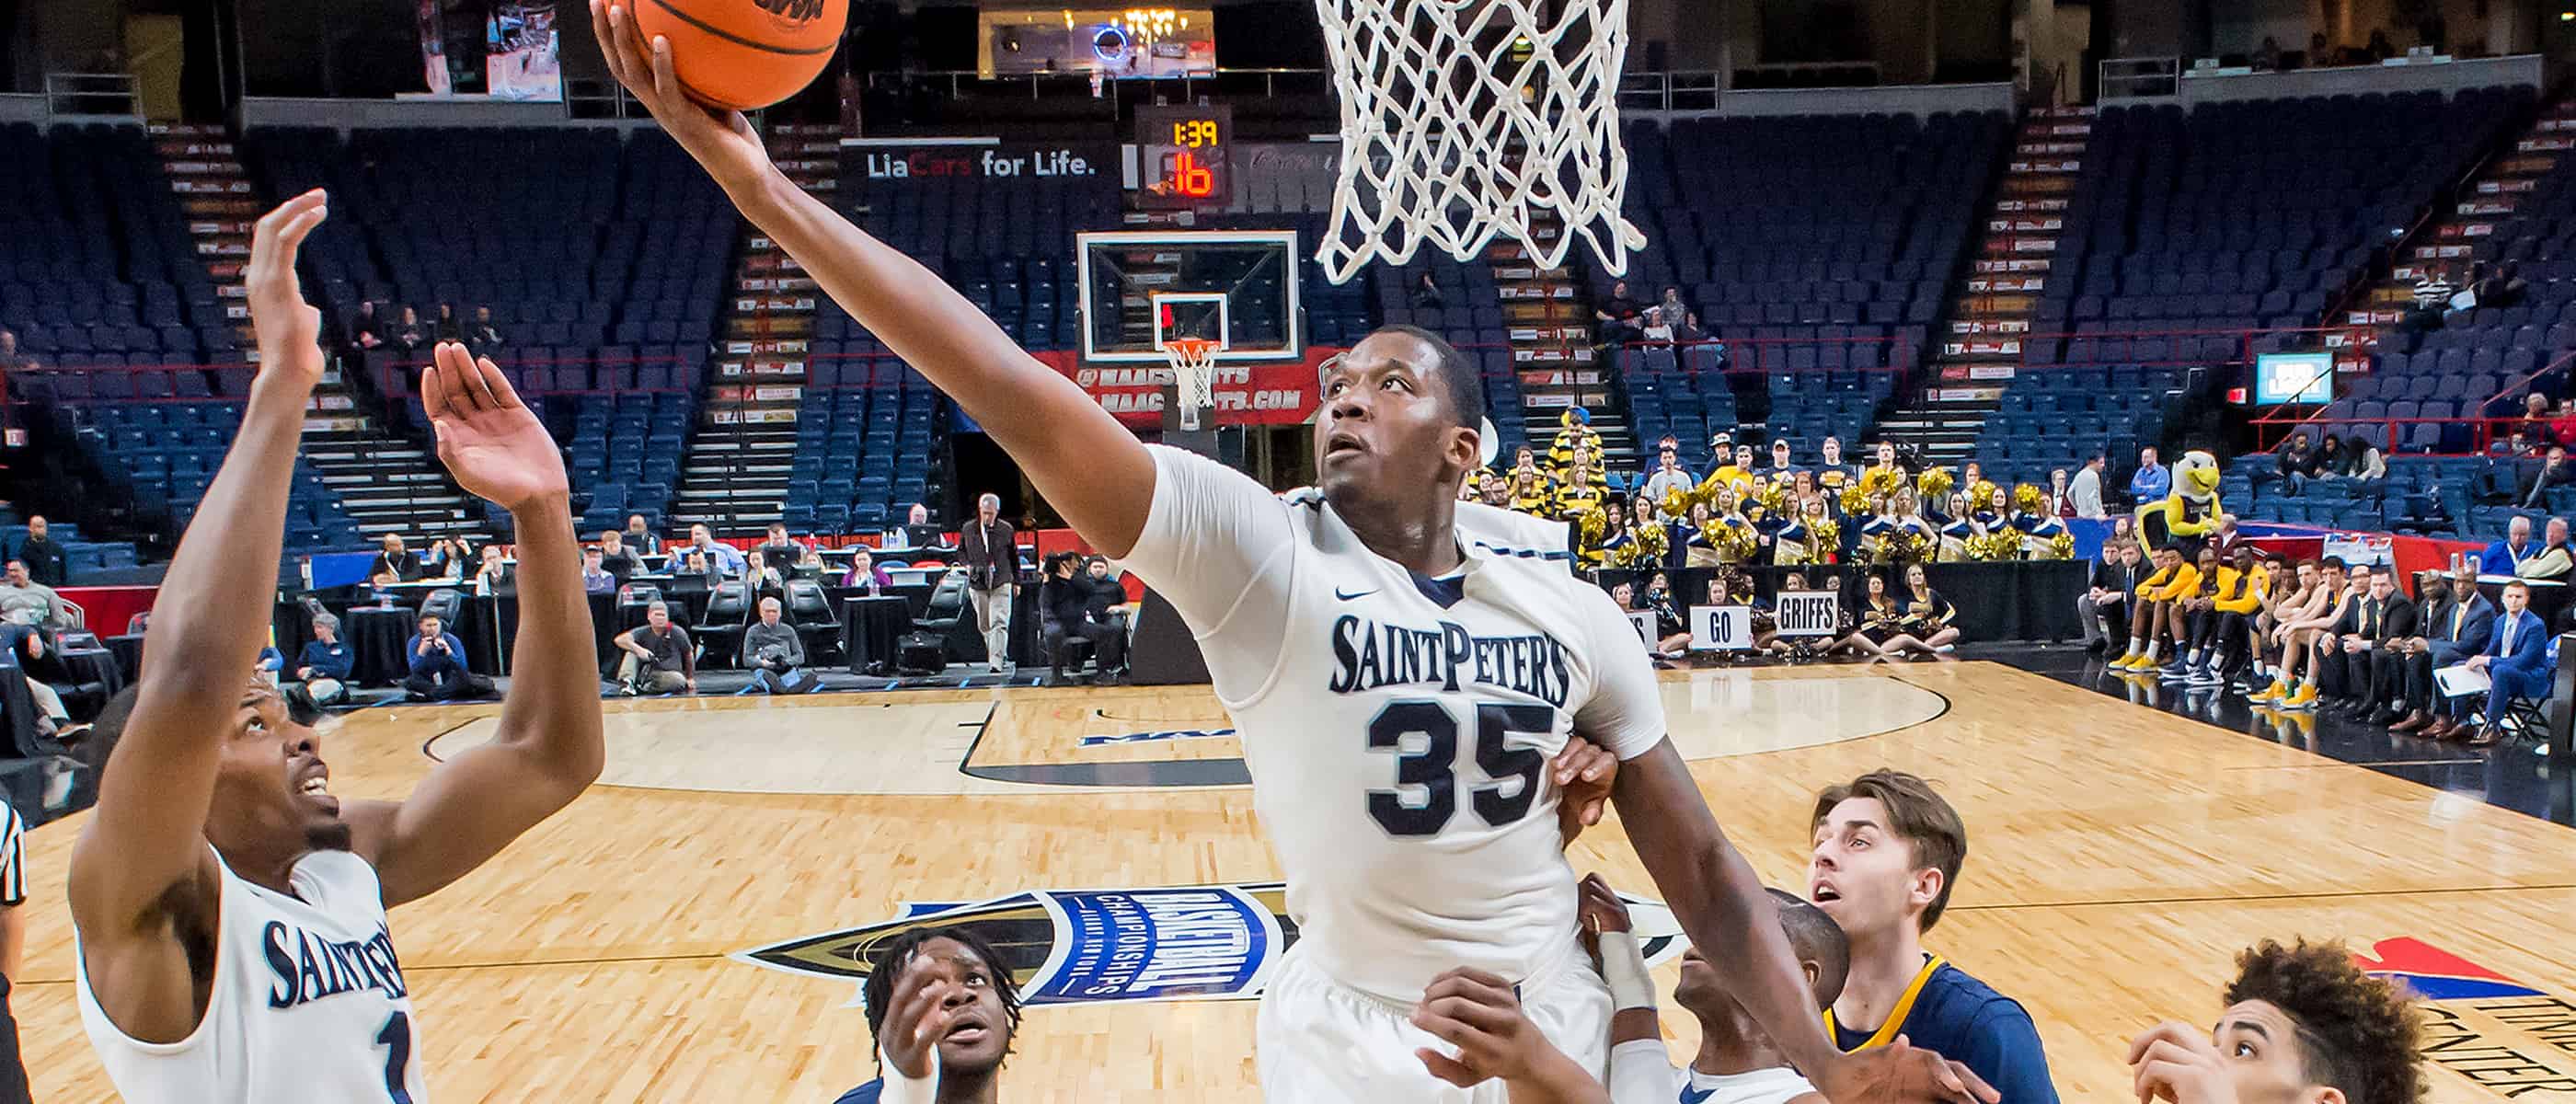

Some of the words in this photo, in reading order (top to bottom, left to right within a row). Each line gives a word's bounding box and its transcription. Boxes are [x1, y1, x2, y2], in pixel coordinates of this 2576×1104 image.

[1174, 120, 1217, 148] 1:39
[982, 150, 1025, 177] for
[1034, 149, 1096, 177] Life.
[1176, 152, 1214, 197] 16
[1709, 611, 1731, 643] GO
[1780, 597, 1834, 629] GRIFFS
[1366, 699, 1555, 837] 35
[1085, 895, 1149, 995] CHAMPIONSHIPS
